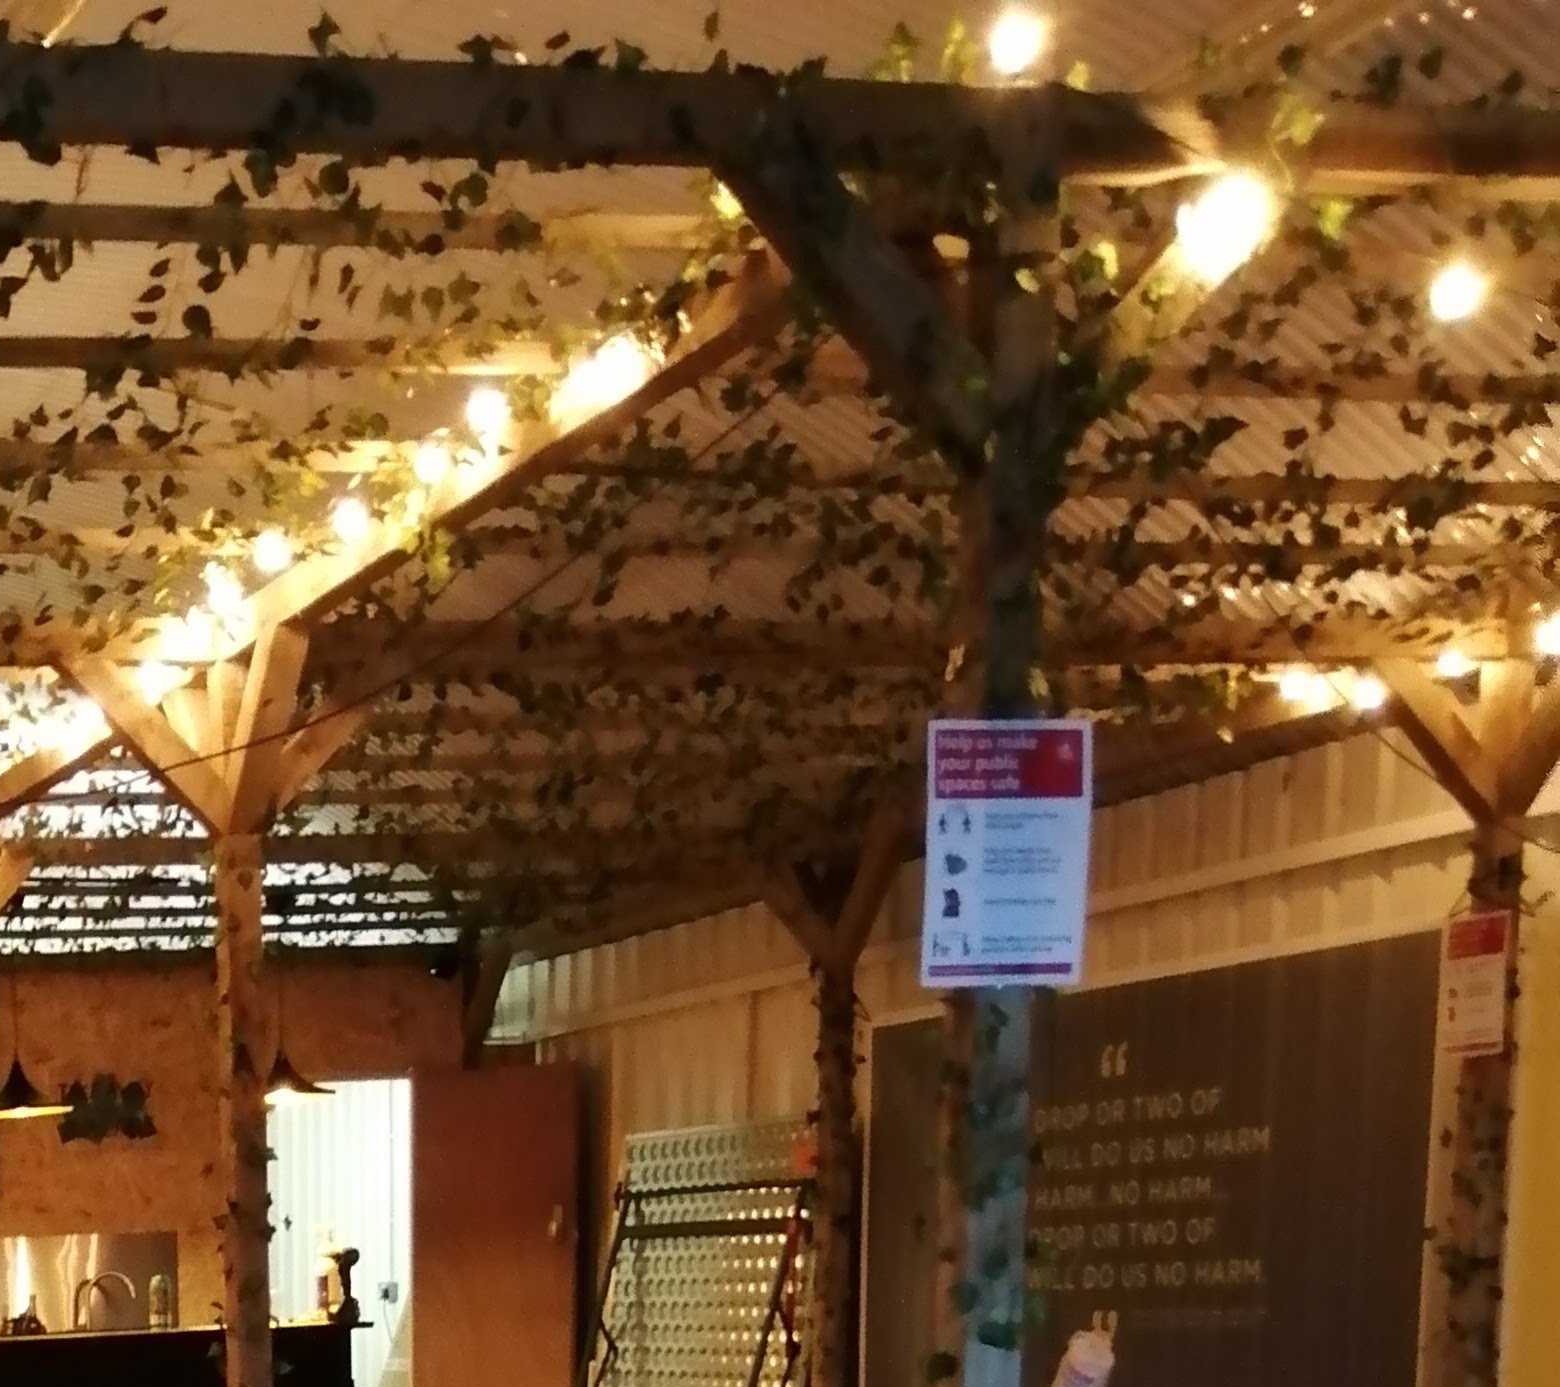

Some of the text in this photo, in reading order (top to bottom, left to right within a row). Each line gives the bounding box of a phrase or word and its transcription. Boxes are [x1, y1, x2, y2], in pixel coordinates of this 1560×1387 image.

[938, 734, 1038, 754] Help us make
[938, 758, 970, 777] your
[1034, 1088, 1223, 1134] DROP OR TWO OF
[1090, 1140, 1122, 1167] DO
[1129, 1137, 1156, 1165] US
[1163, 1133, 1195, 1159] NO
[1203, 1125, 1270, 1157] HARM
[1092, 1222, 1121, 1248] OR
[1128, 1218, 1177, 1246] TWO
[1186, 1217, 1216, 1245] OF
[1082, 1264, 1115, 1289] DO
[1121, 1263, 1147, 1288] US
[1154, 1260, 1187, 1287] NO
